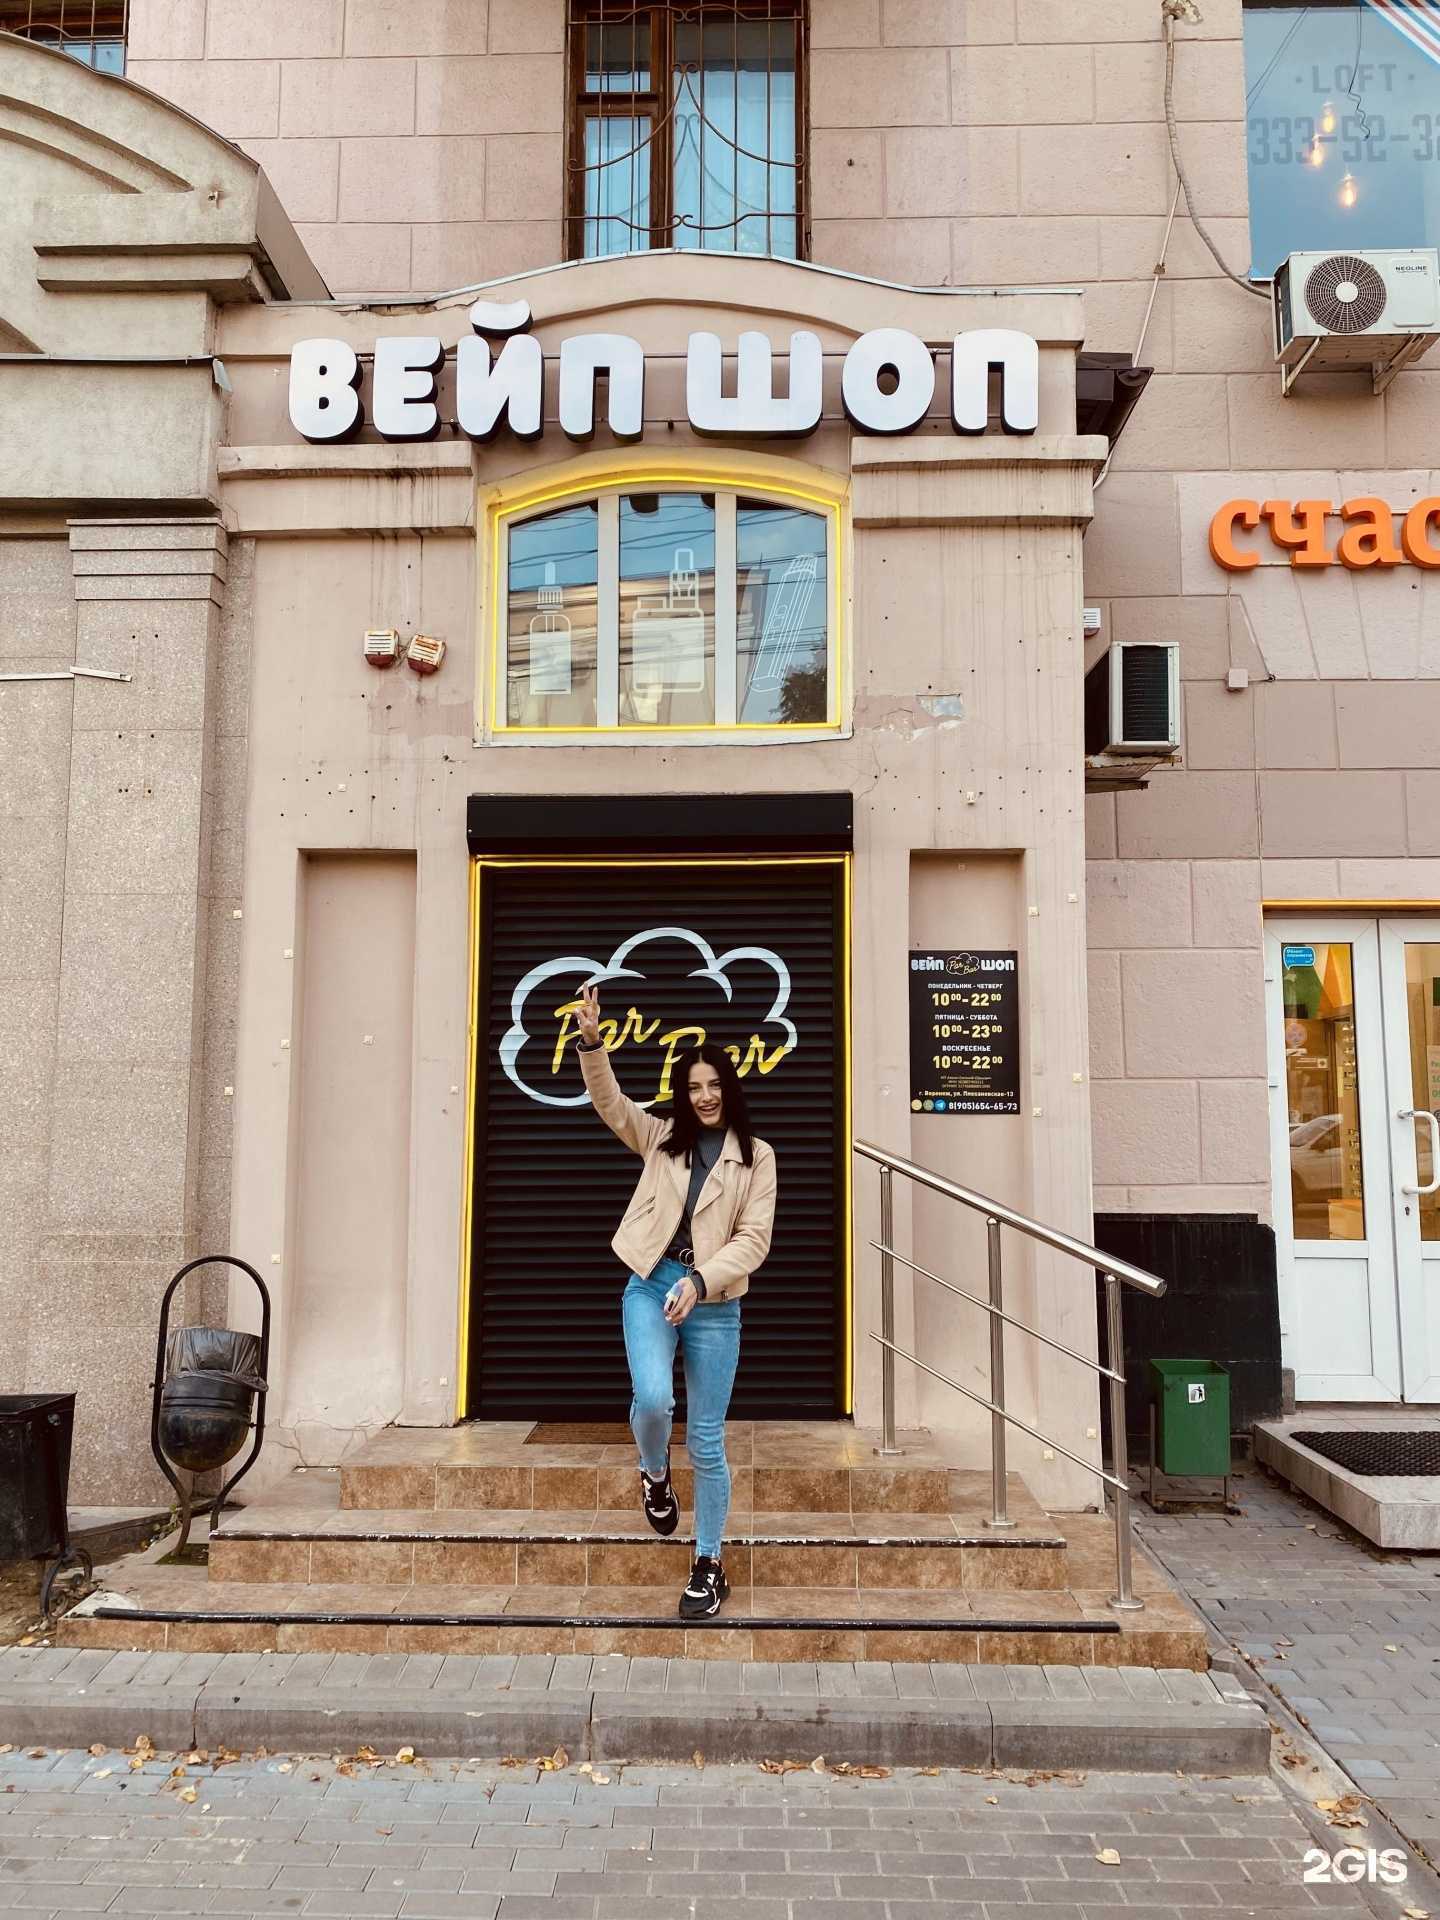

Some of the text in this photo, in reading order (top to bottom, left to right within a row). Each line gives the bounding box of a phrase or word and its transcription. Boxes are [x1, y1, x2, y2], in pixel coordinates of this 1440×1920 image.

[1312, 64, 1397, 93] LOFT
[288, 300, 1039, 445] ВЕЙП ШОП
[911, 956, 944, 971] ВЕЙП
[981, 959, 1015, 971] ШОП
[949, 1102, 1018, 1110] 8(905)654-65-73
